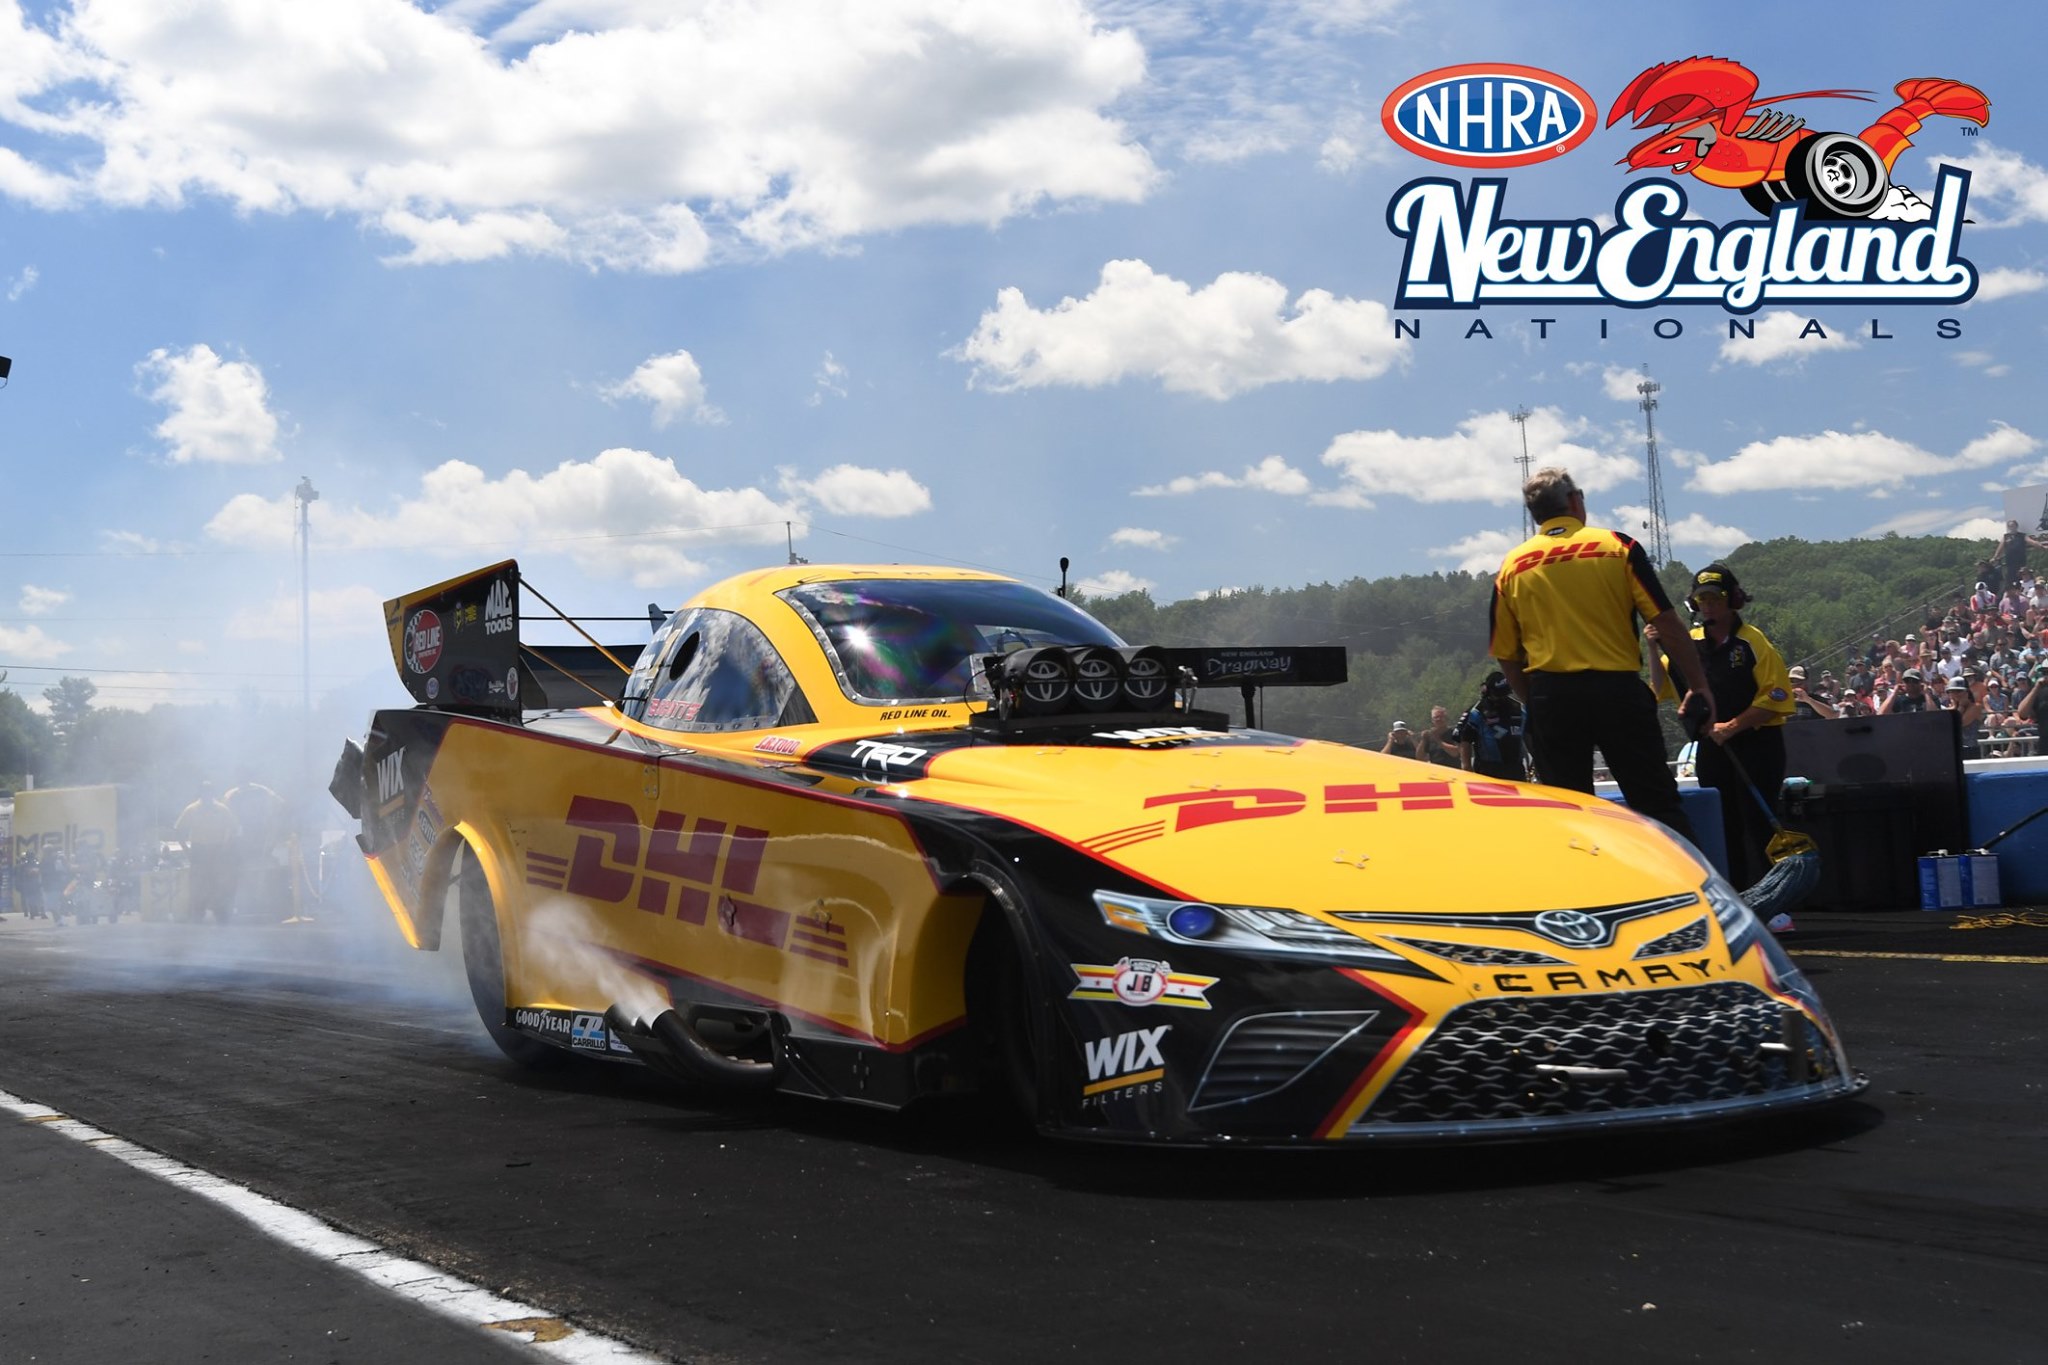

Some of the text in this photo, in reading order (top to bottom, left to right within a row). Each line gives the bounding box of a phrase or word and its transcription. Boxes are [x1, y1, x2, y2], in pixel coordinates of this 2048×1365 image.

[1513, 541, 1606, 576] DHL
[485, 579, 513, 621] MAC
[485, 616, 513, 637] TOOLS
[1207, 655, 1292, 677] Dragway
[880, 710, 902, 721] RED
[904, 709, 929, 719] LINE
[850, 739, 928, 772] TRD
[376, 746, 405, 804] WIX
[1143, 781, 1581, 833] DHL
[564, 794, 790, 950] DHL
[515, 1008, 570, 1034] GOODYEAR
[572, 1036, 606, 1050] CARRILLO
[1084, 1024, 1166, 1081] WIX
[1081, 1081, 1163, 1110] FILTERS
